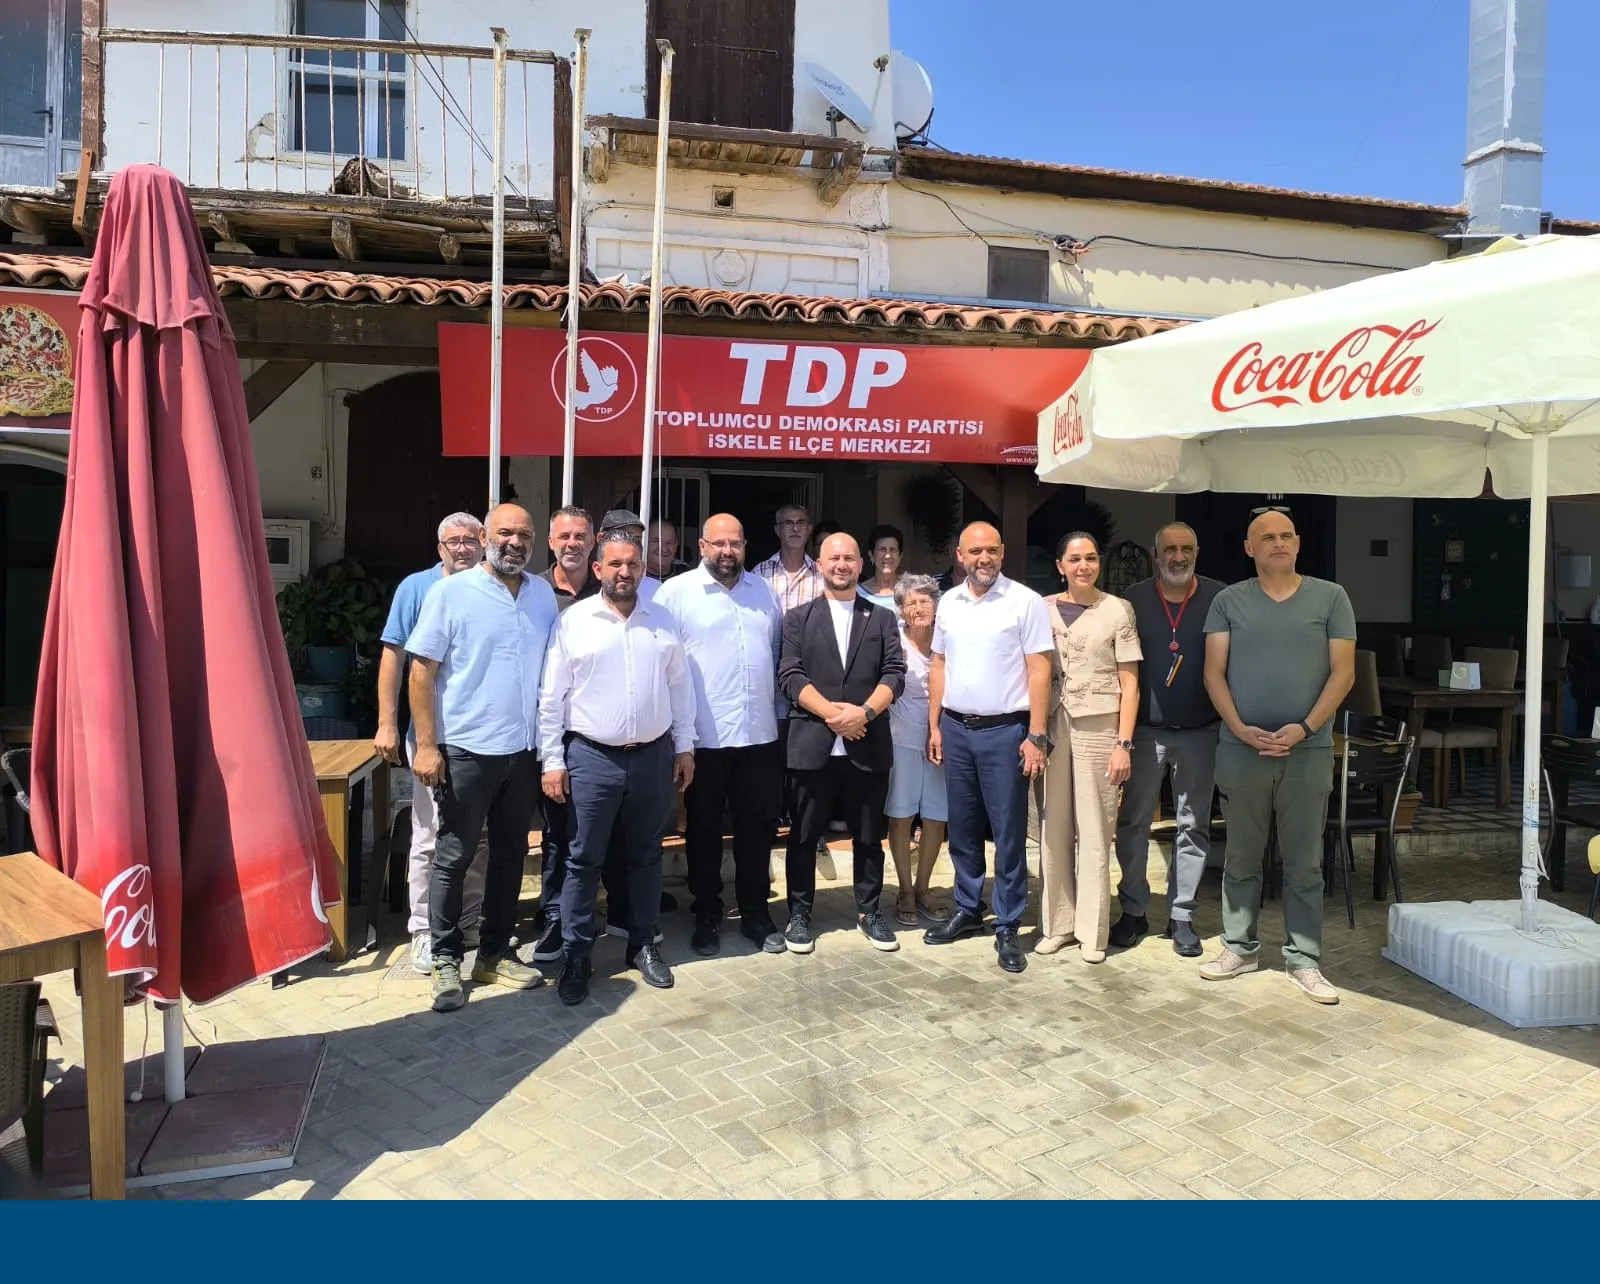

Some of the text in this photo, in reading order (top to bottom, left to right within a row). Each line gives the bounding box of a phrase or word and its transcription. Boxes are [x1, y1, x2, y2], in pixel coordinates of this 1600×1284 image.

[729, 342, 907, 409] TDP
[1212, 316, 1444, 412] Coca-Cola
[594, 406, 613, 414] TDP
[652, 410, 771, 429] TOPLUMCU
